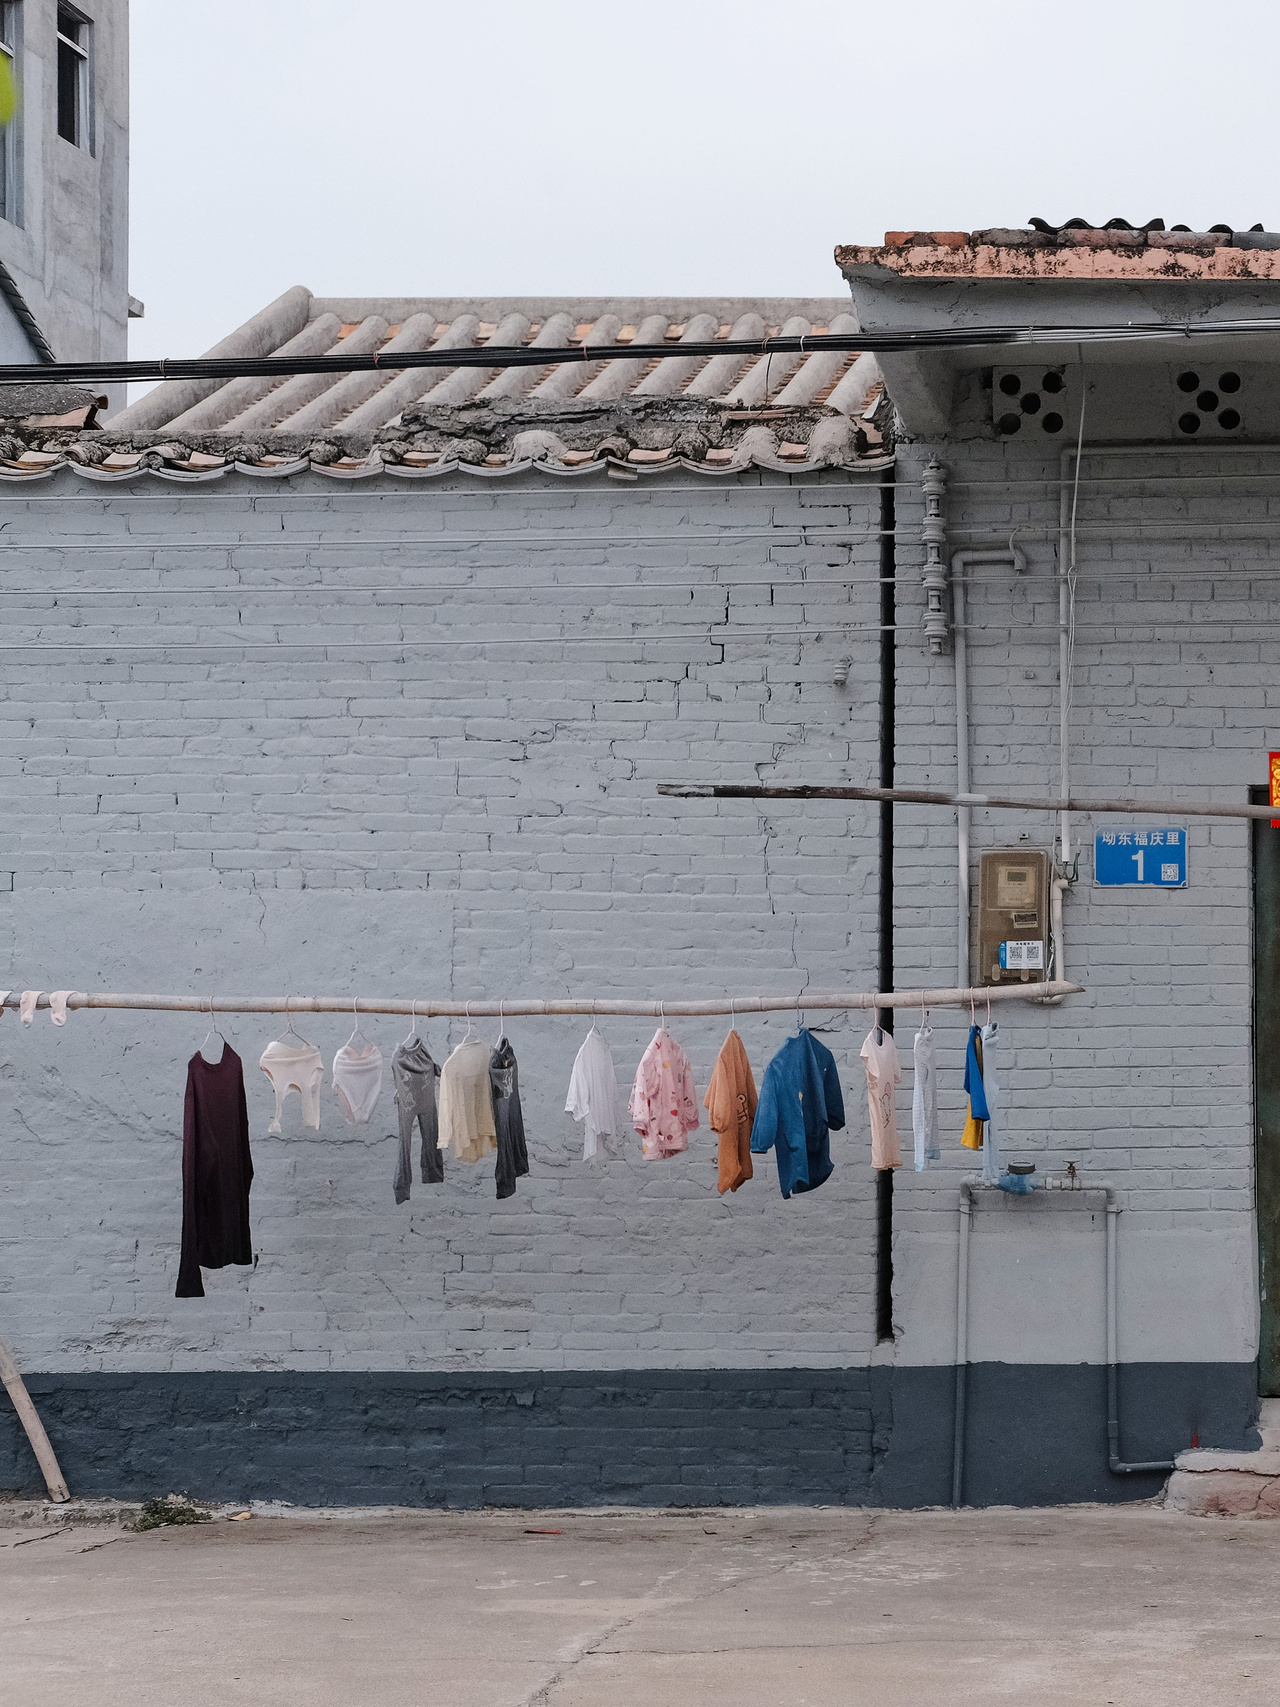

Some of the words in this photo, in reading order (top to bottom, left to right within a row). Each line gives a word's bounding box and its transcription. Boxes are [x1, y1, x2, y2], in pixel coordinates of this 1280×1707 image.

[1102, 831, 1180, 846] 坳东福庆里
[1131, 849, 1144, 881] 1
